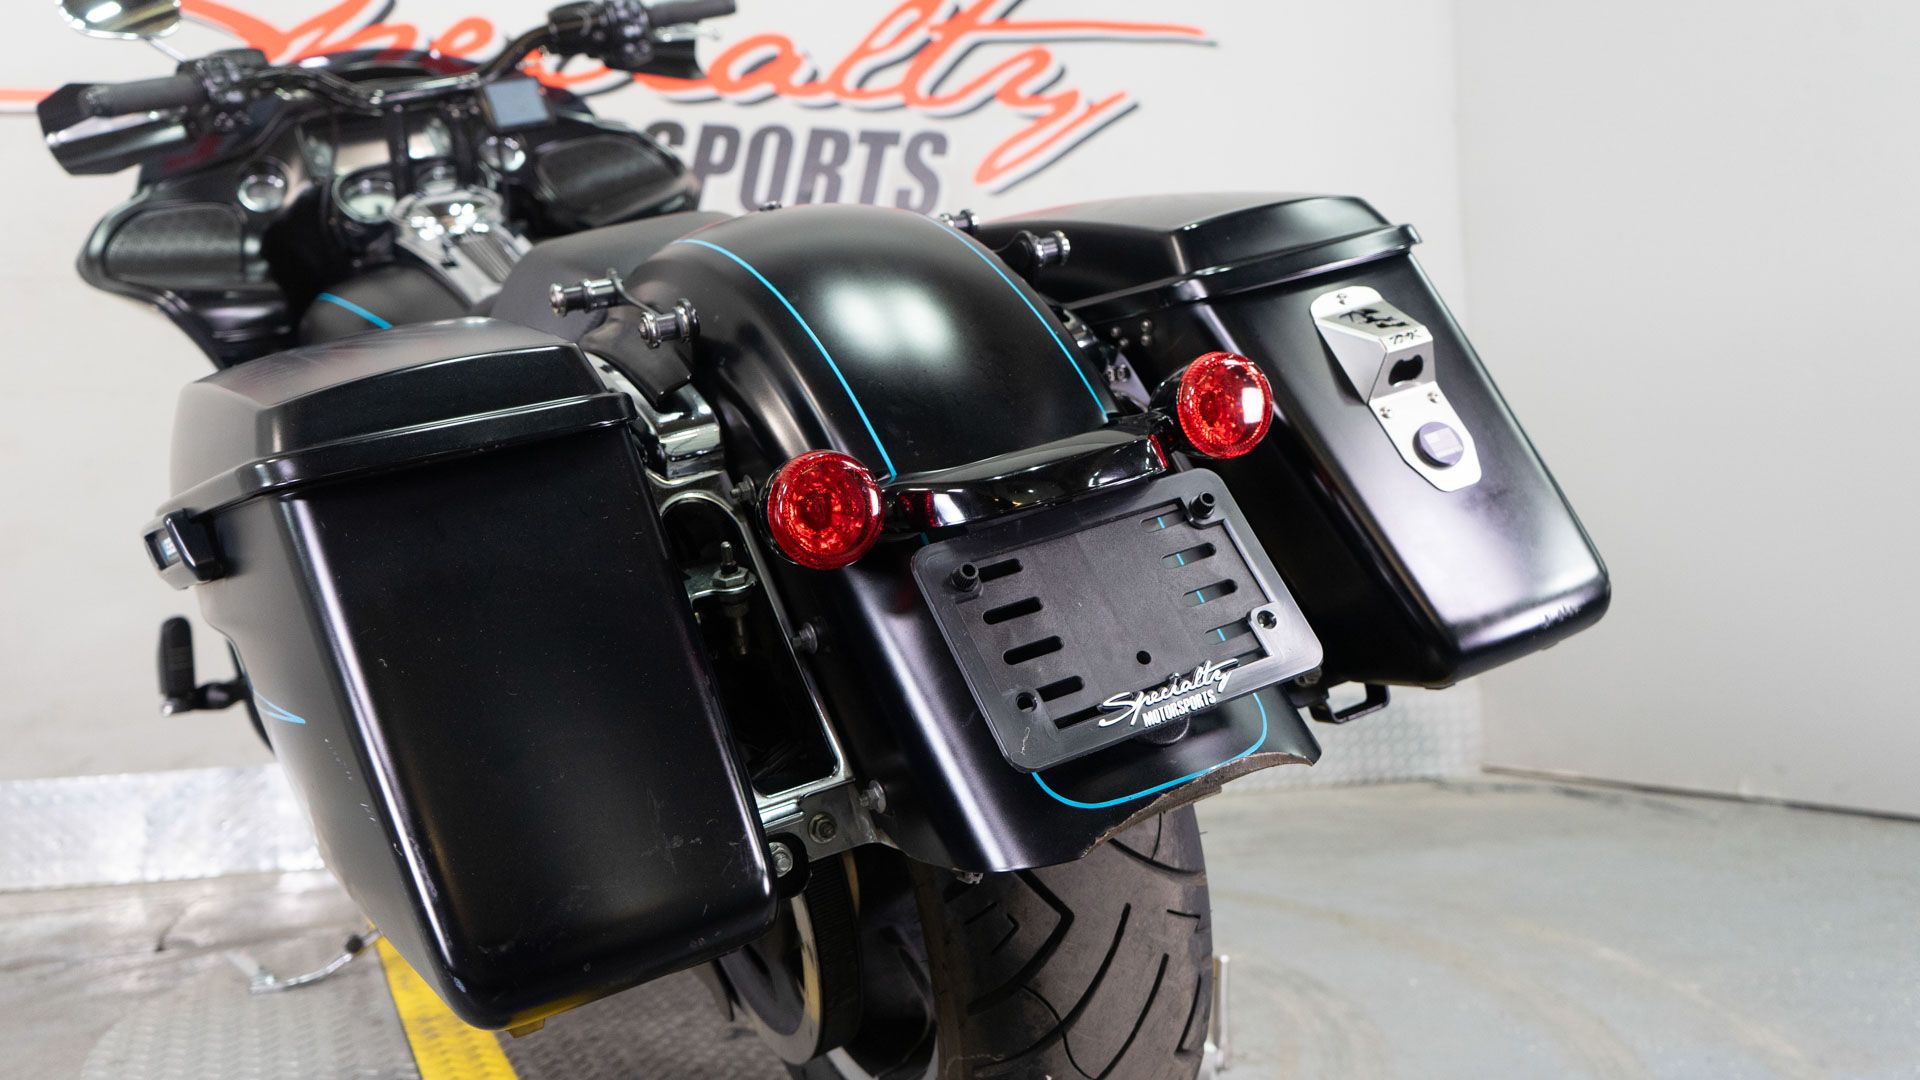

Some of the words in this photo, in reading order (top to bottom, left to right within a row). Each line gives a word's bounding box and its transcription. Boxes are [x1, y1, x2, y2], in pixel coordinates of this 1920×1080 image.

[0, 0, 1217, 193] pecalty
[1098, 658, 1239, 727] Specialty
[1142, 689, 1217, 727] MOTORSPORTS
